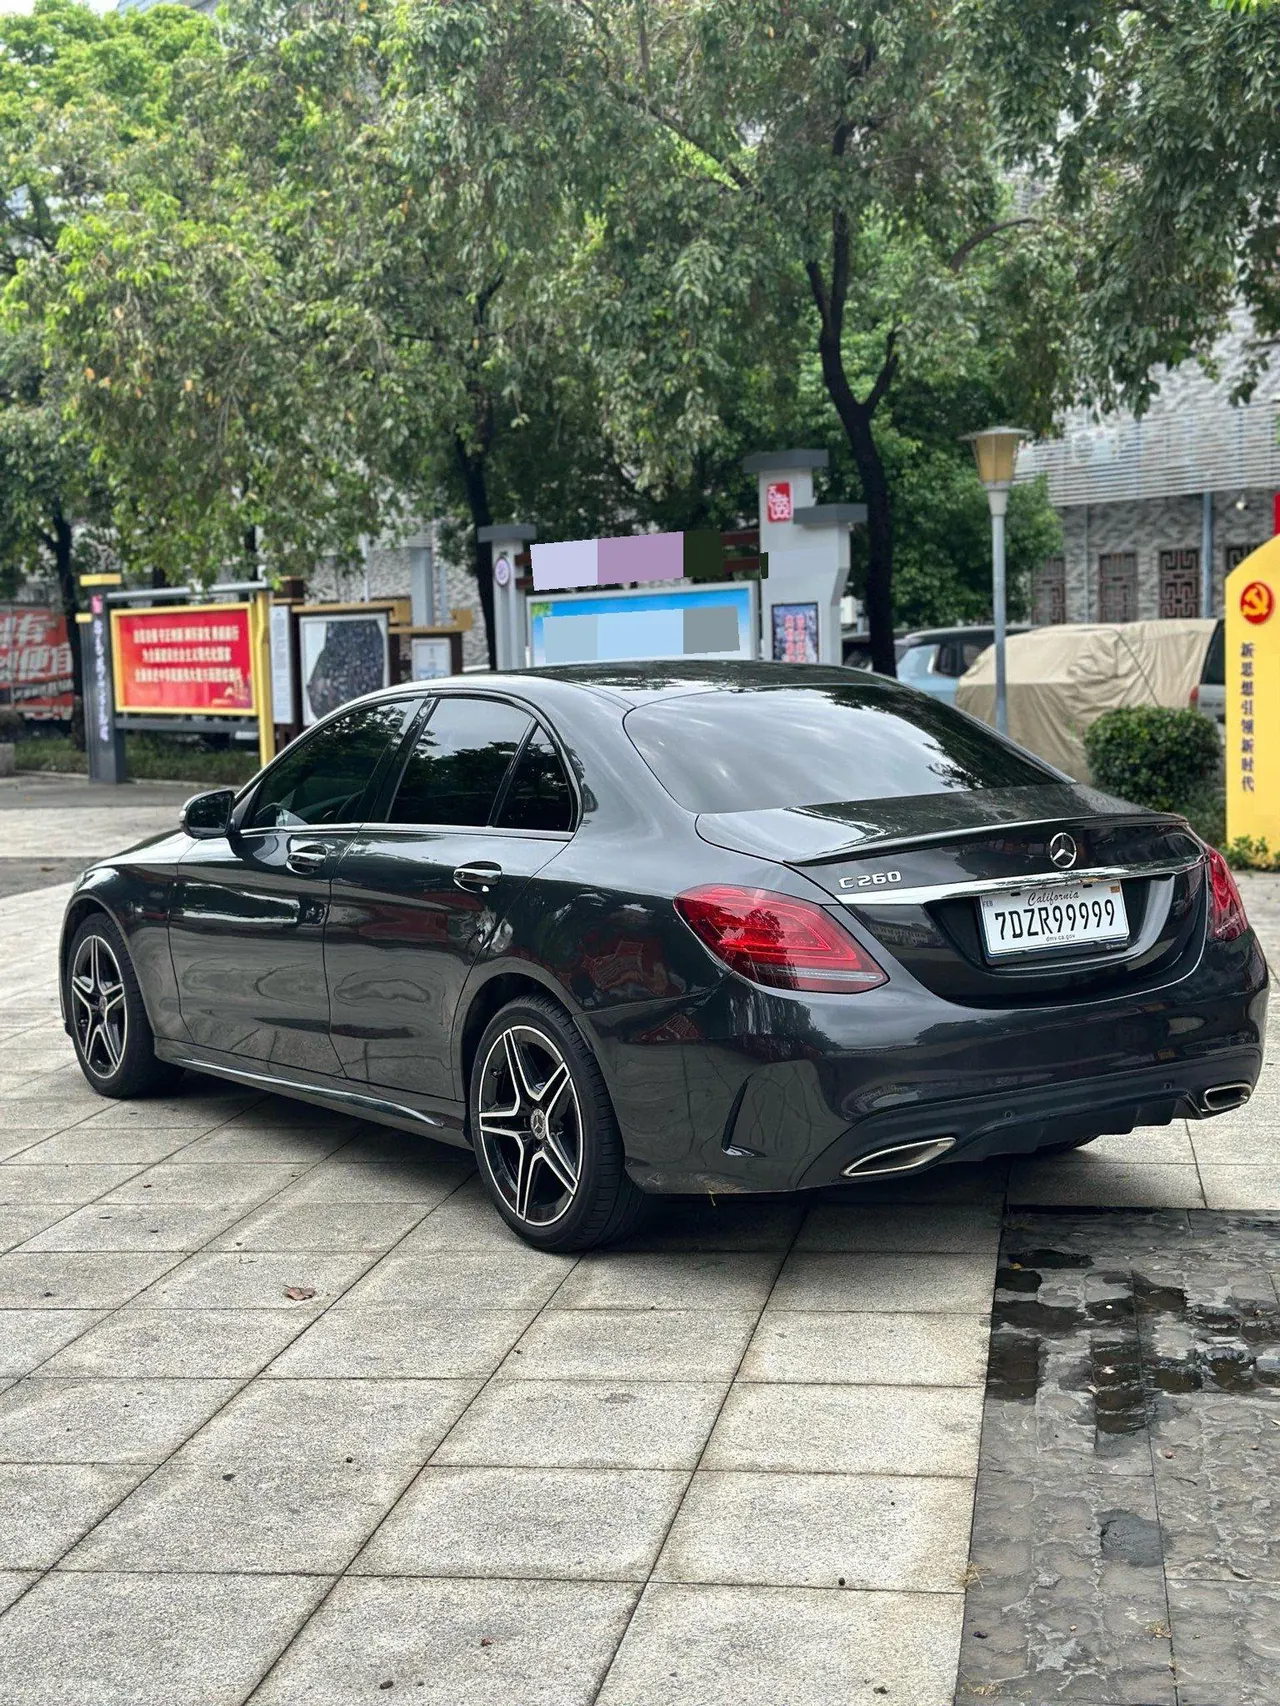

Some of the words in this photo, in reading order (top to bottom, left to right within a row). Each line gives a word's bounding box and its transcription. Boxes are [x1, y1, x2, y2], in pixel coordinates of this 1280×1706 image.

[1240, 642, 1255, 793] 新思想引领新时代
[838, 877, 854, 889] C
[857, 870, 902, 887] 260
[1027, 890, 1080, 907] California
[994, 898, 1115, 941] 7DZR99999
[1045, 933, 1076, 942] dmv.ca.gov
